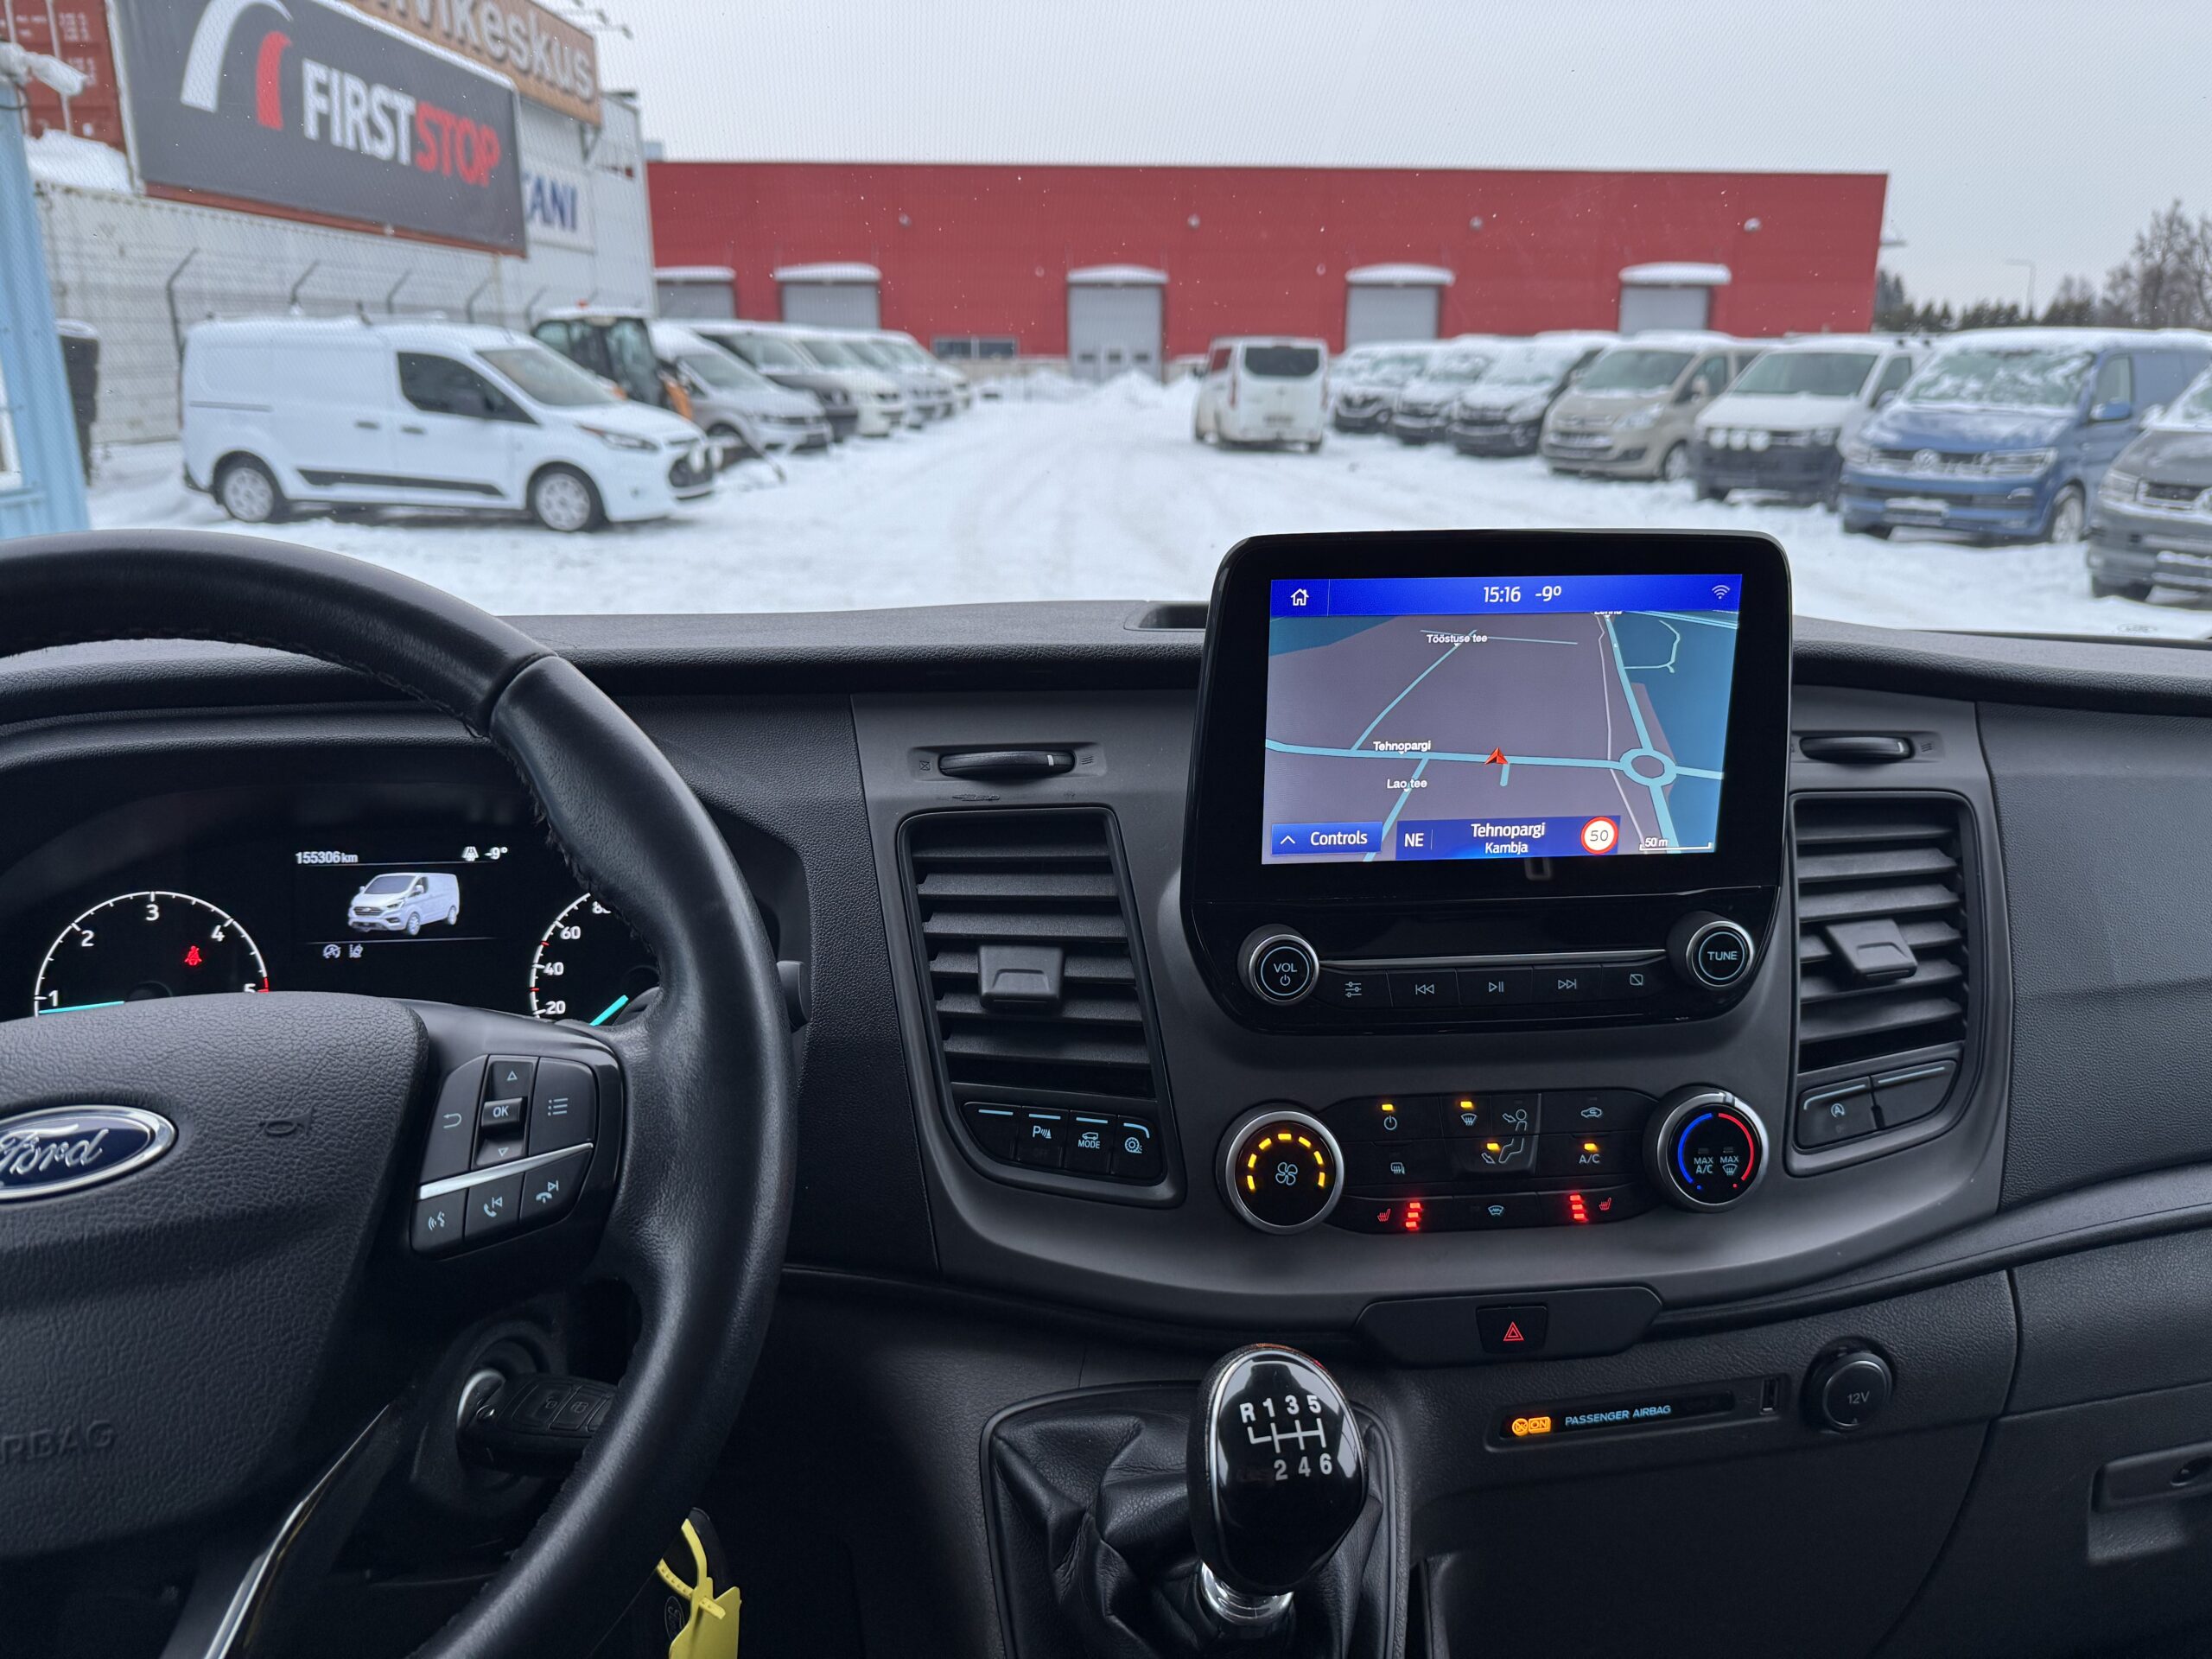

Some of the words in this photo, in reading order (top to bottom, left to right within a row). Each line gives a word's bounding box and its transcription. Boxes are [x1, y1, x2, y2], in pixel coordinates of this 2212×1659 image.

[521, 172, 577, 231] ANI
[1484, 586, 1521, 603] 15:16
[1427, 633, 1471, 644] Tööstuse
[1472, 634, 1488, 643] tee
[1373, 741, 1431, 752] Tehnopargi
[1387, 779, 1407, 789] Lao
[1410, 779, 1427, 788] tee
[1471, 823, 1546, 838] Tehnopargi
[1590, 830, 1609, 842] 50
[1310, 830, 1368, 846] Controls
[1404, 832, 1424, 847] NE
[1644, 837, 1657, 847] 50
[1484, 842, 1529, 855] Kambja
[145, 904, 160, 921] 3
[81, 930, 95, 947] 2
[211, 925, 225, 942] 4
[560, 925, 582, 940] 60
[1707, 950, 1738, 961] TUNE
[543, 962, 564, 976] 40
[1273, 963, 1298, 973] VOL
[48, 989, 59, 1007] 1
[545, 1001, 566, 1014] 20
[493, 1105, 509, 1117] OK
[0, 1123, 109, 1176] Ford
[1077, 1139, 1100, 1149] MODE
[1579, 1154, 1601, 1165] A/C
[1694, 1156, 1714, 1166] MAX
[1719, 1155, 1739, 1164] MAX
[1695, 1165, 1713, 1175] A/C
[1847, 1390, 1870, 1404] 12V
[1239, 1402, 1255, 1423] R
[1262, 1397, 1275, 1418] 1
[1285, 1395, 1300, 1414] 3
[1306, 1394, 1322, 1414] 5
[1565, 1409, 1630, 1426] PASSENGER
[1632, 1405, 1671, 1418] AIRBAG
[1530, 1419, 1548, 1430] ON
[1274, 1459, 1288, 1480] 2
[1298, 1456, 1312, 1477] 4
[1319, 1452, 1332, 1474] 6
